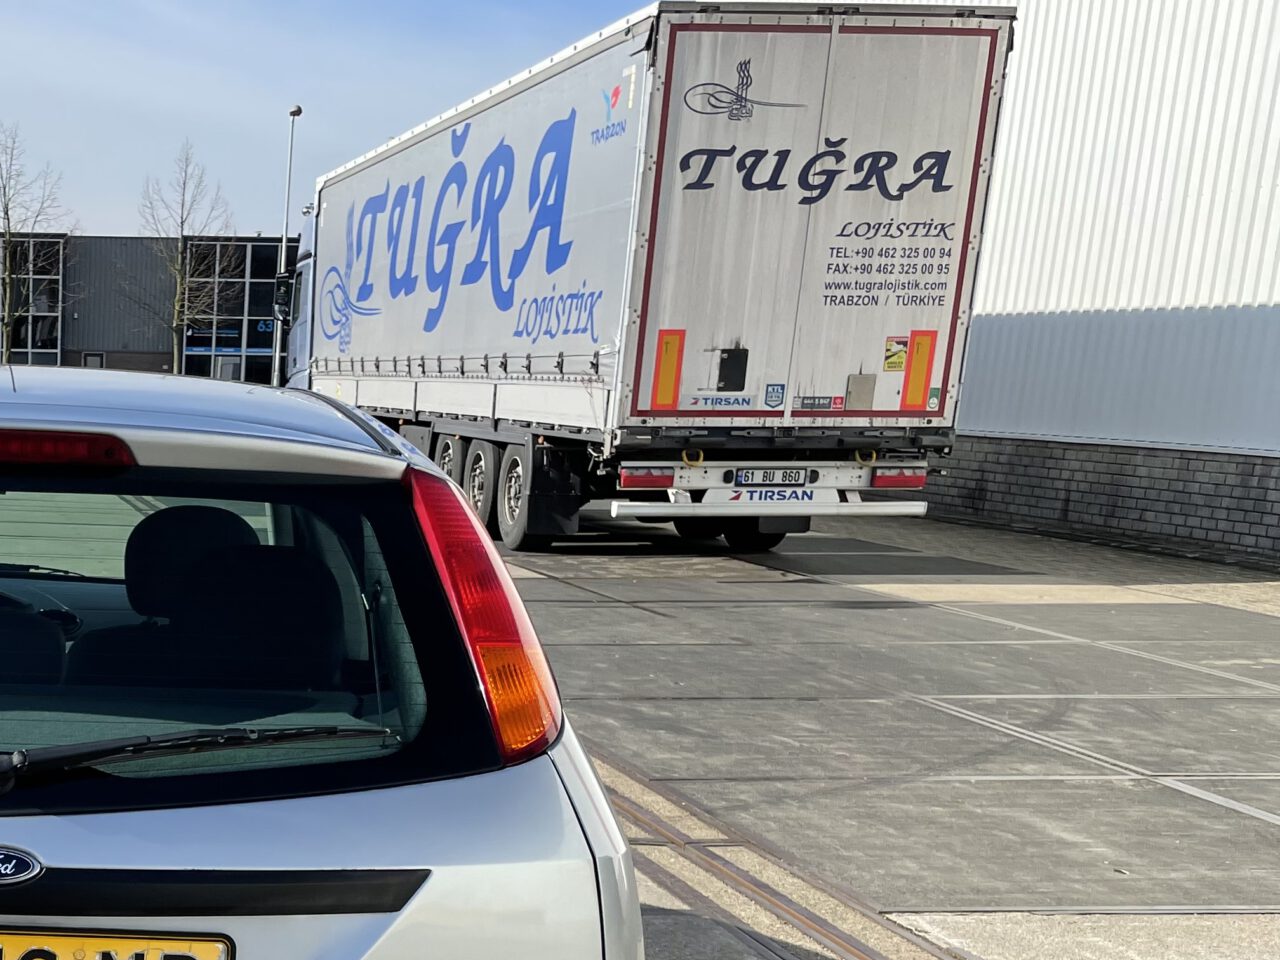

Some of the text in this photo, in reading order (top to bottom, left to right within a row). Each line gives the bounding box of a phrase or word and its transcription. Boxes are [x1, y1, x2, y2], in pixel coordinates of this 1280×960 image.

[591, 119, 627, 145] TRABZON
[679, 137, 954, 205] TUĞRA
[356, 107, 577, 333] TUĞRA
[835, 218, 956, 241] LOJİSTİK
[829, 247, 952, 259] TEL:+90 462 325 00 94
[826, 263, 950, 275] FAX:+90 462 325 00 95
[824, 279, 948, 293] www.tugralojistik.com
[823, 295, 879, 307] TRABZON
[895, 292, 946, 307] TÜRKİYE
[512, 279, 603, 345] LOJİSTİK
[257, 320, 274, 332] 63
[702, 397, 751, 406] TIRSAN
[743, 471, 800, 482] 61 BU 860
[746, 490, 814, 501] TIRSAN
